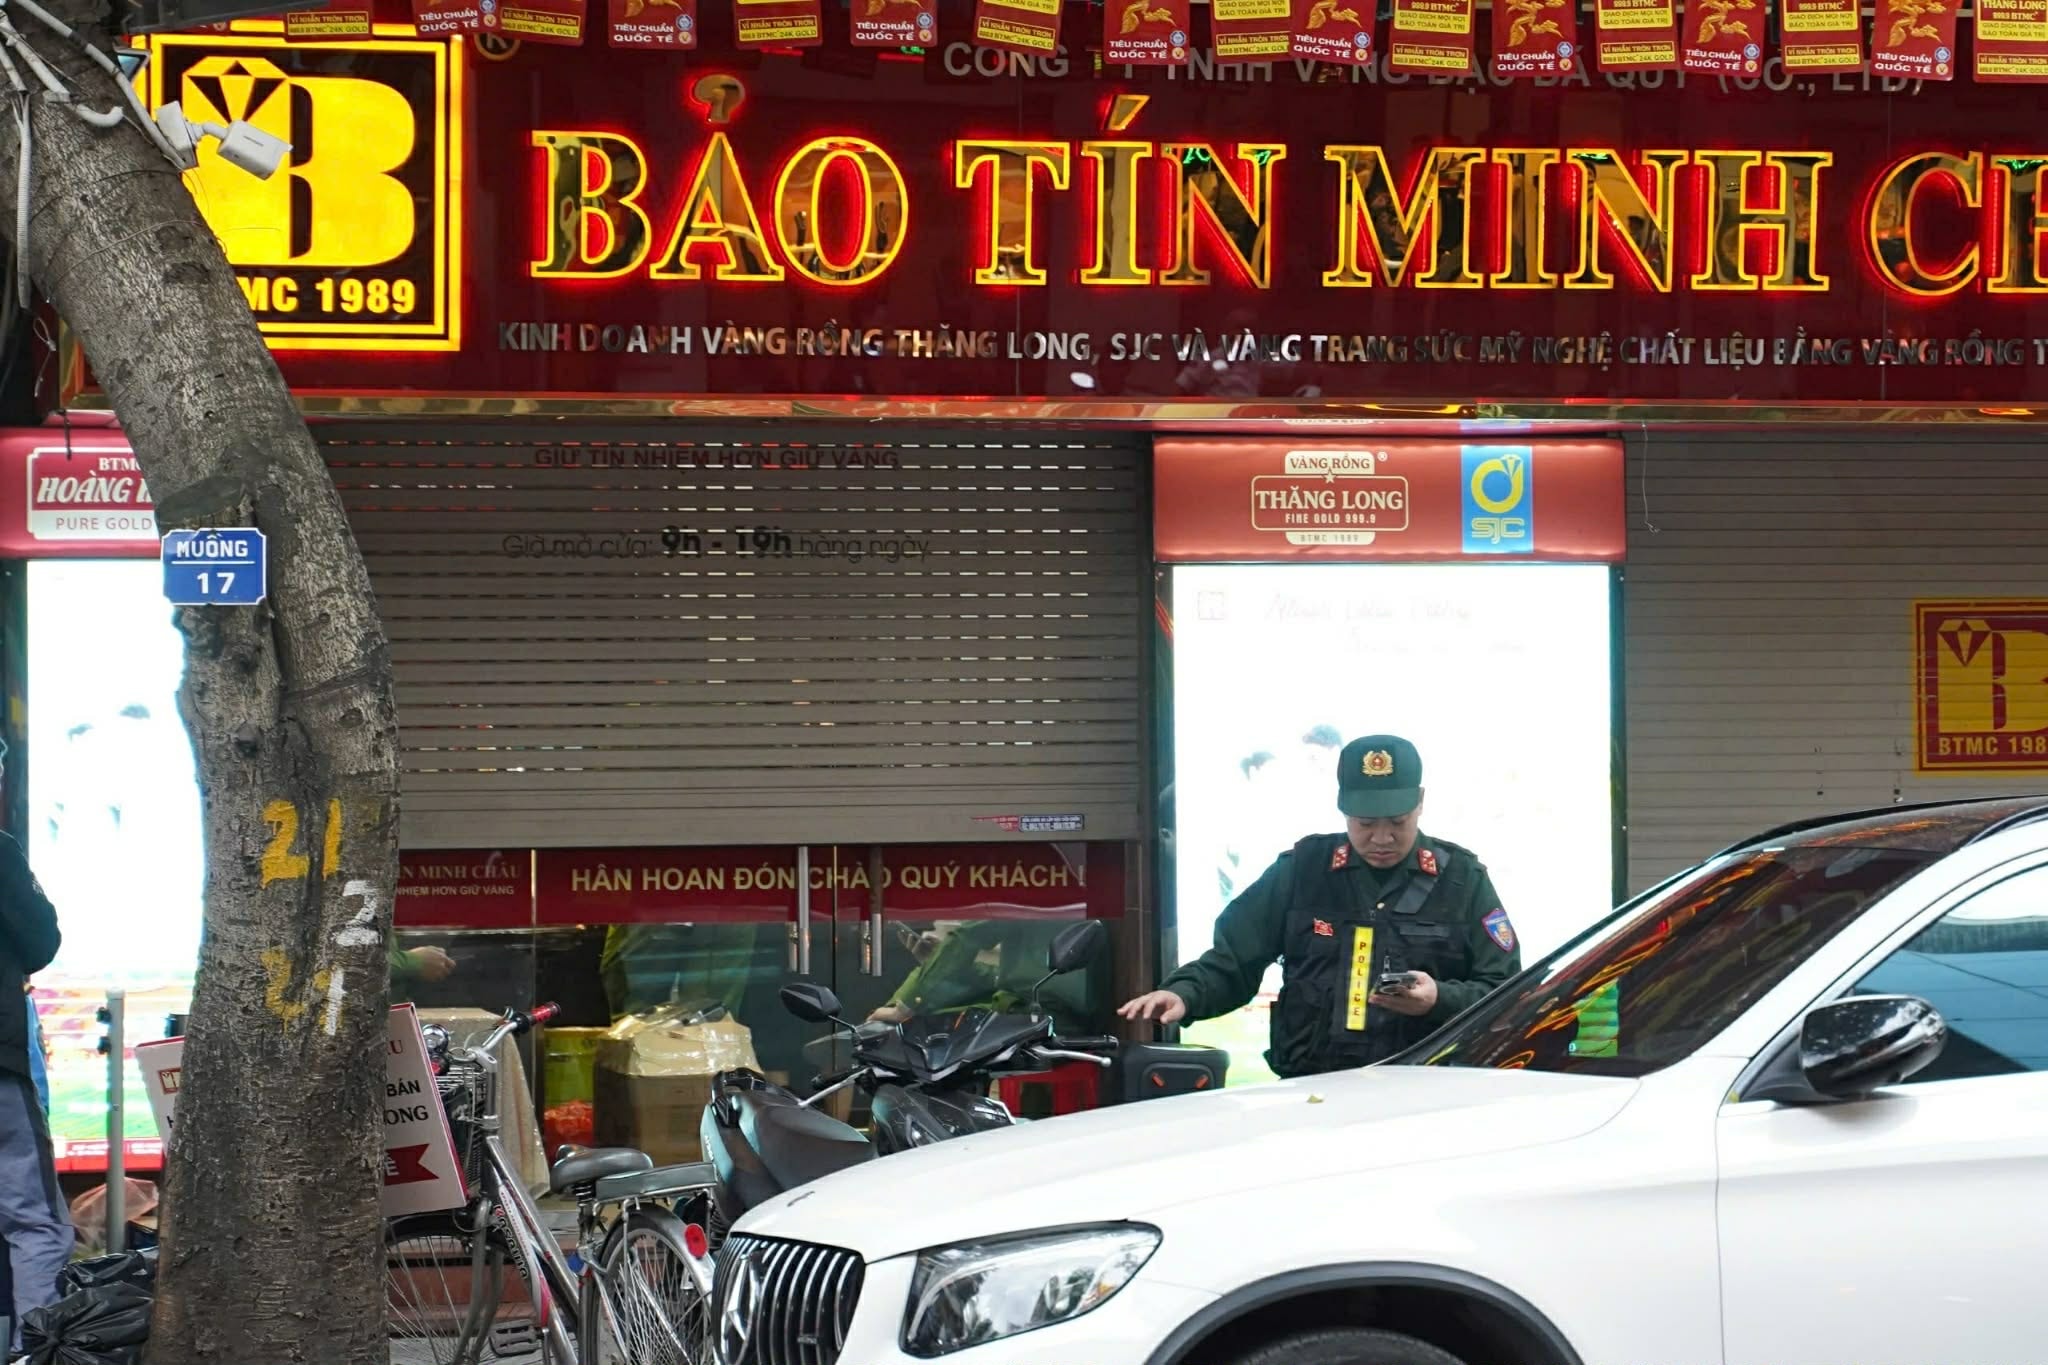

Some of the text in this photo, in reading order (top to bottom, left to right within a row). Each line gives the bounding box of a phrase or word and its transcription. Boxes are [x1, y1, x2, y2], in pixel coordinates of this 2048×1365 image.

[419, 9, 478, 21] TIÊU CHUẨN
[420, 17, 479, 32] QUỐC TẾ
[614, 22, 674, 33] TIÊU CHUẨN
[856, 20, 915, 31] TIÊU CHUẨN
[614, 32, 673, 43] QUỐC TẾ
[856, 30, 915, 41] QUỐC TẾ
[1295, 34, 1352, 49] TIÊU CHUẨN
[1109, 39, 1167, 49] TIÊU CHUẨN
[1293, 44, 1350, 58] QUỐC TẾ
[1109, 49, 1167, 59] QUỐC TẾ
[1497, 50, 1555, 61] TIÊU CHUẨN
[1686, 49, 1742, 61] TIÊU CHUẨN
[1876, 52, 1932, 64] TIÊU CHUẨN
[1497, 60, 1555, 71] QUỐC TẾ
[1684, 58, 1741, 71] QUỐC TẾ
[1875, 62, 1932, 74] QUỐC TẾ
[529, 74, 909, 287] BẢO
[954, 93, 1288, 289] TÍN
[1322, 144, 1834, 292] MINH
[315, 277, 416, 314] 1989
[500, 321, 572, 351] KINH
[579, 323, 691, 354] DOANH
[702, 320, 786, 355] VÀNG
[796, 318, 883, 357] RỒNG
[893, 322, 997, 359] THĂNG
[1007, 332, 1099, 365] LONG,
[1110, 332, 1163, 361] SJC
[1172, 327, 1211, 361] VÀ
[1221, 327, 1301, 362] VÀNG
[1310, 334, 1409, 363] TRANG
[1414, 329, 1472, 363] SỨC
[1479, 331, 1524, 364] MỸ
[1533, 331, 1613, 371] NGHỆ
[1620, 328, 1696, 365] CHẤT
[1704, 331, 1765, 371] LIỆU
[1773, 326, 1852, 366] BẰNG
[1861, 329, 1938, 366] VÀNG
[1945, 328, 2025, 366] RỒNG
[1290, 453, 1371, 469] VÀNG RỒNG
[37, 470, 134, 503] HOÀNG
[1255, 485, 1404, 510] THĂNG LONG
[56, 517, 153, 531] PURE GOLD
[1285, 513, 1376, 524] FINE GOLD 999.9
[1471, 517, 1526, 544] SJC
[661, 525, 702, 558] 9h
[735, 525, 792, 558] 19h
[800, 533, 862, 563] hàng
[868, 533, 929, 563] ngày
[1300, 533, 1328, 543] BTMC
[197, 573, 235, 595] 17
[1938, 736, 1999, 755] BTMC
[261, 799, 342, 889] 21
[419, 864, 467, 879] MINH
[472, 861, 520, 879] CHÂU
[571, 863, 632, 892] HÂN
[643, 867, 725, 891] HOAN
[733, 861, 795, 890] ĐÓN
[900, 860, 961, 890] QUÝ
[969, 860, 1069, 888] KHÁCH
[483, 883, 514, 895] VÀNG
[1353, 941, 1367, 1016] POLICE
[386, 1077, 421, 1098] BÁN
[385, 1105, 429, 1126] ONG
